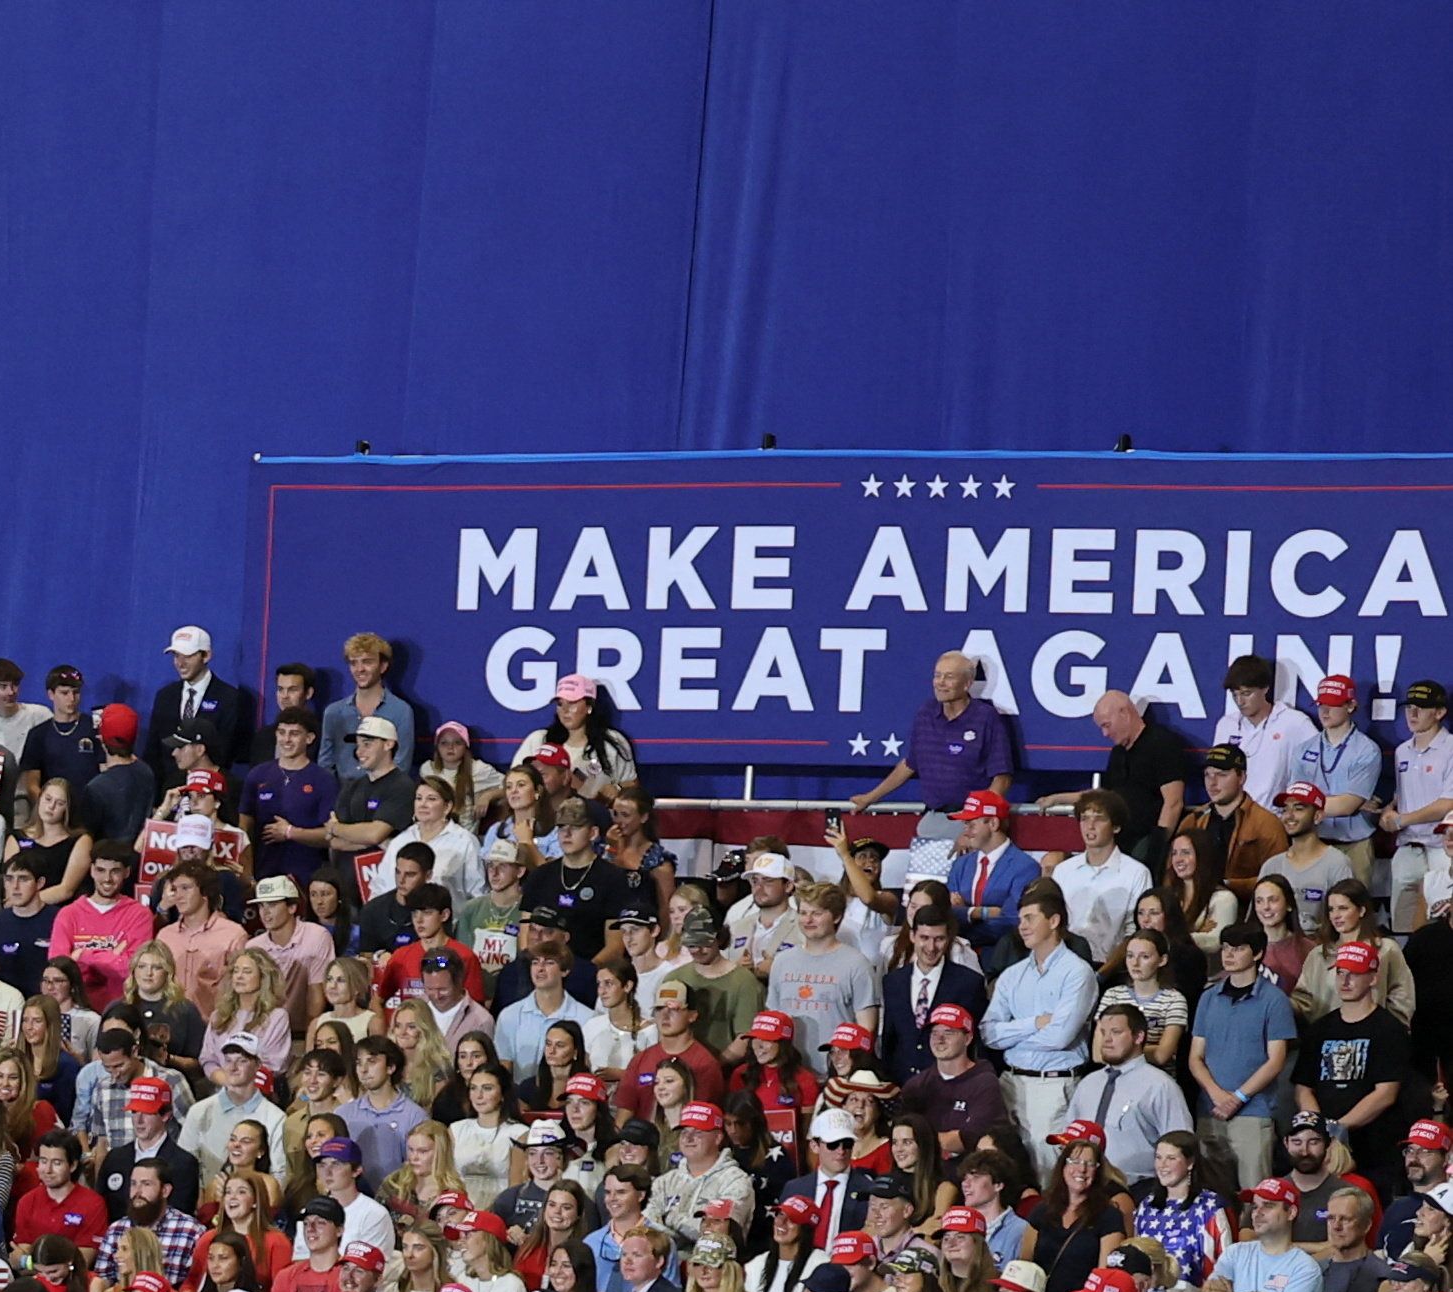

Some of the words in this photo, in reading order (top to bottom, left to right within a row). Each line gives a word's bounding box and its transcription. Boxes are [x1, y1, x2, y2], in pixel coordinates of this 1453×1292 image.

[457, 526, 795, 611] MAKE
[845, 526, 1449, 618] AMERICA
[485, 626, 887, 713] GREAT
[479, 951, 511, 967] KING
[483, 937, 507, 951] MY
